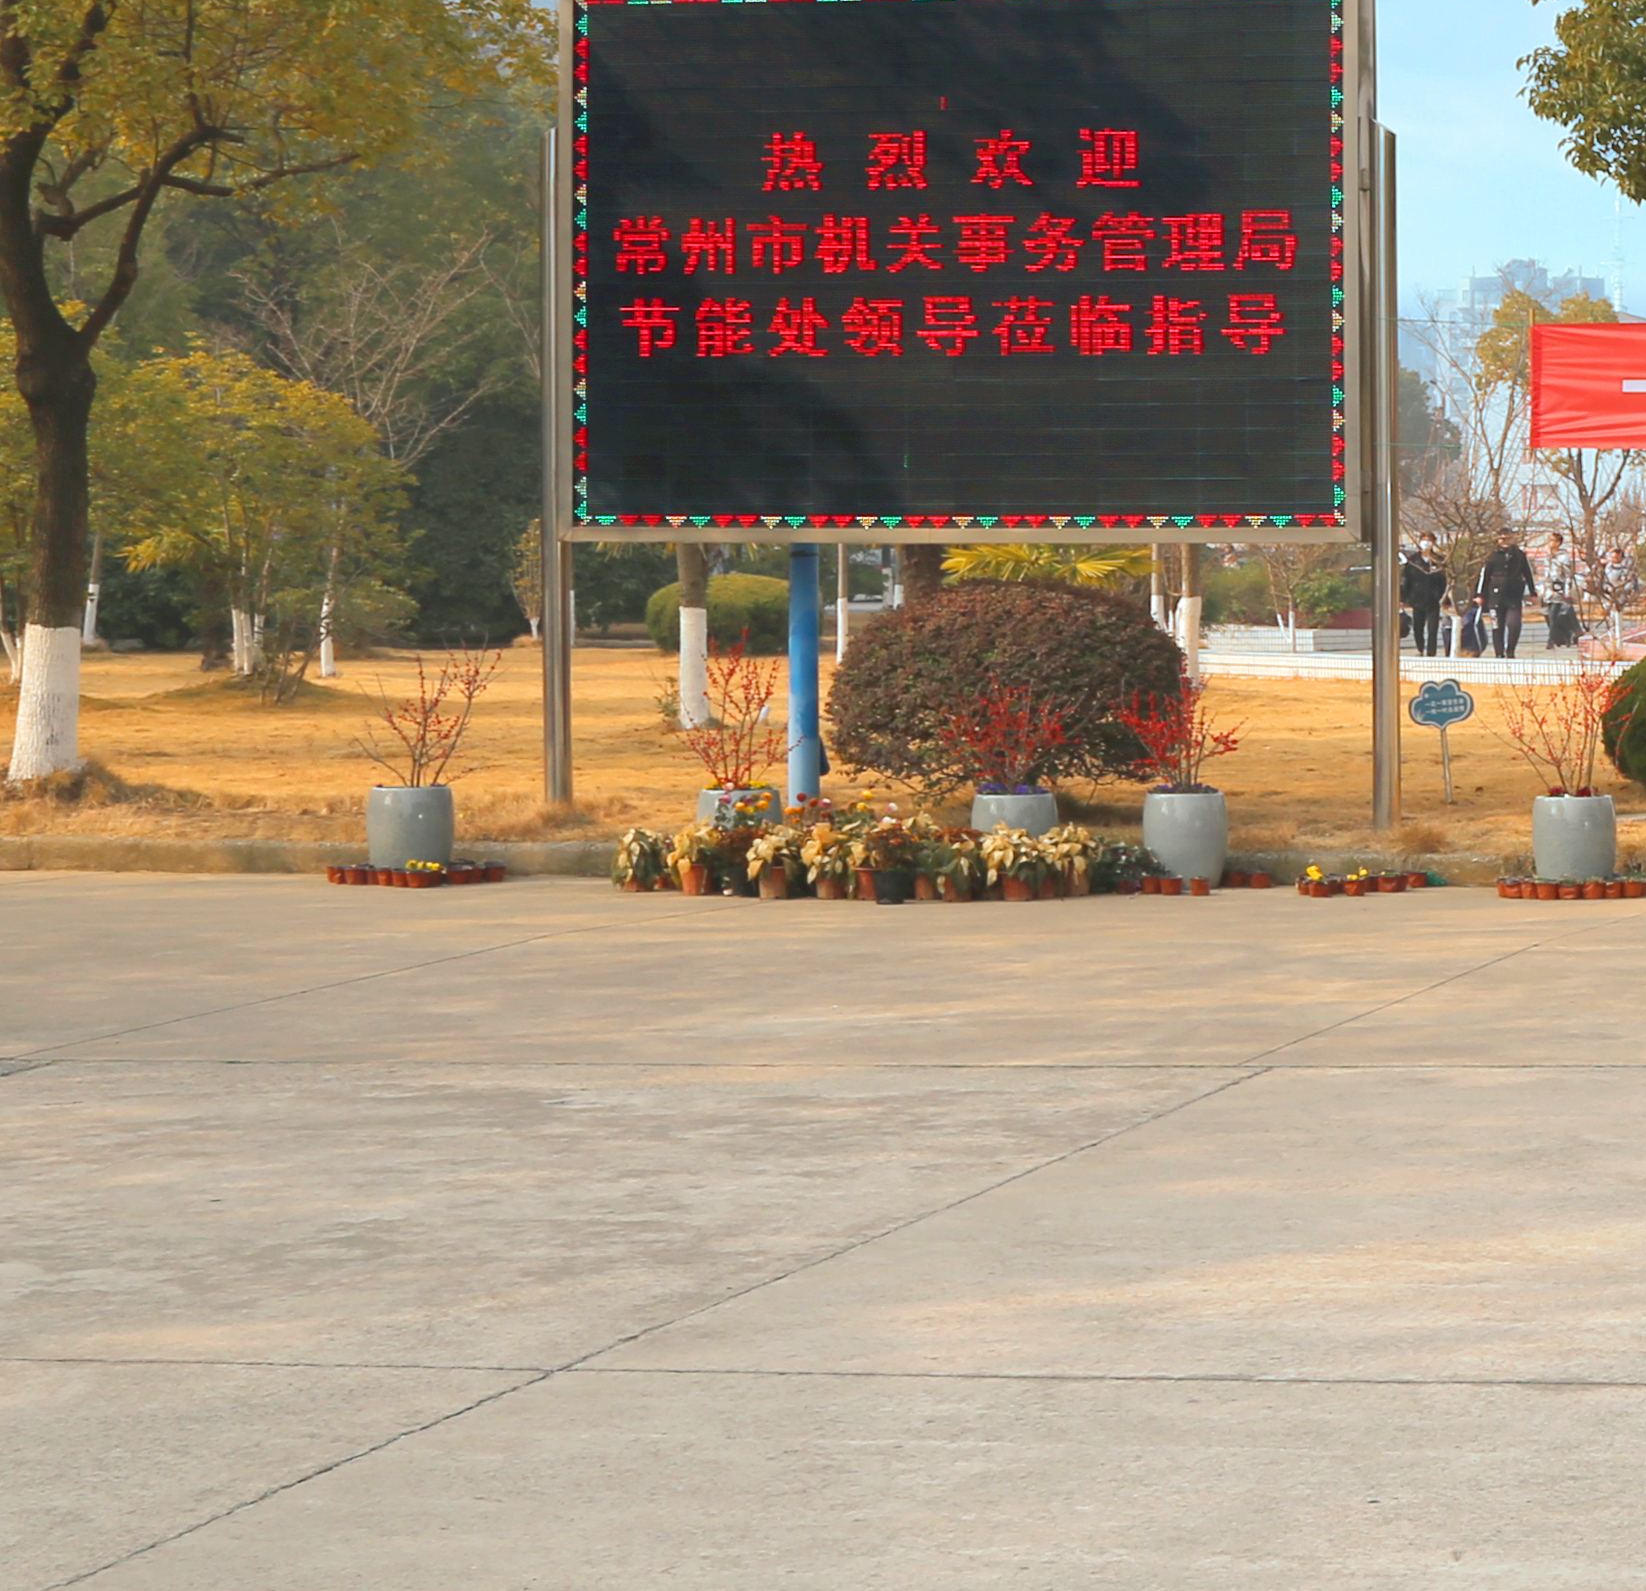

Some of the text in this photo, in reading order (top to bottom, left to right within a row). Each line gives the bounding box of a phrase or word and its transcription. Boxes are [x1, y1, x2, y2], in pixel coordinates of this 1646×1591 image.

[762, 128, 1141, 191] 热烈欢迎
[613, 210, 1298, 274] 常州市机关事务管理局
[620, 294, 1286, 357] 节能处领导莅临指导
